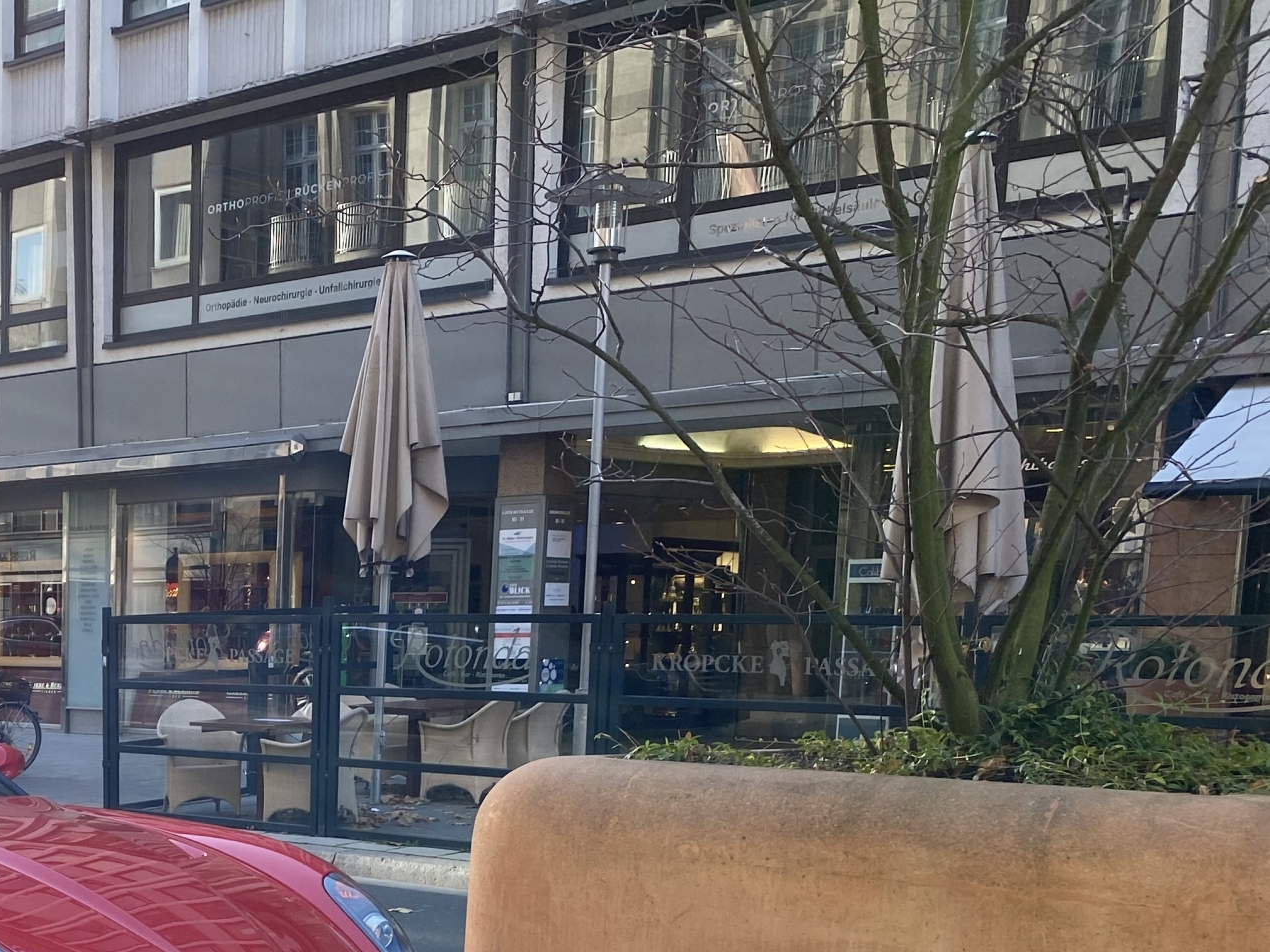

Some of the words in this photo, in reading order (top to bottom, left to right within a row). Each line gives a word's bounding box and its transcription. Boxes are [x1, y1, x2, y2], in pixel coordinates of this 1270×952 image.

[205, 298, 247, 313] Orthopädie
[253, 287, 313, 305] Neurochirurgie
[318, 275, 382, 295] Unfallchirurgie
[390, 624, 530, 676] Rotonda
[651, 650, 764, 674] KRÖPCKE
